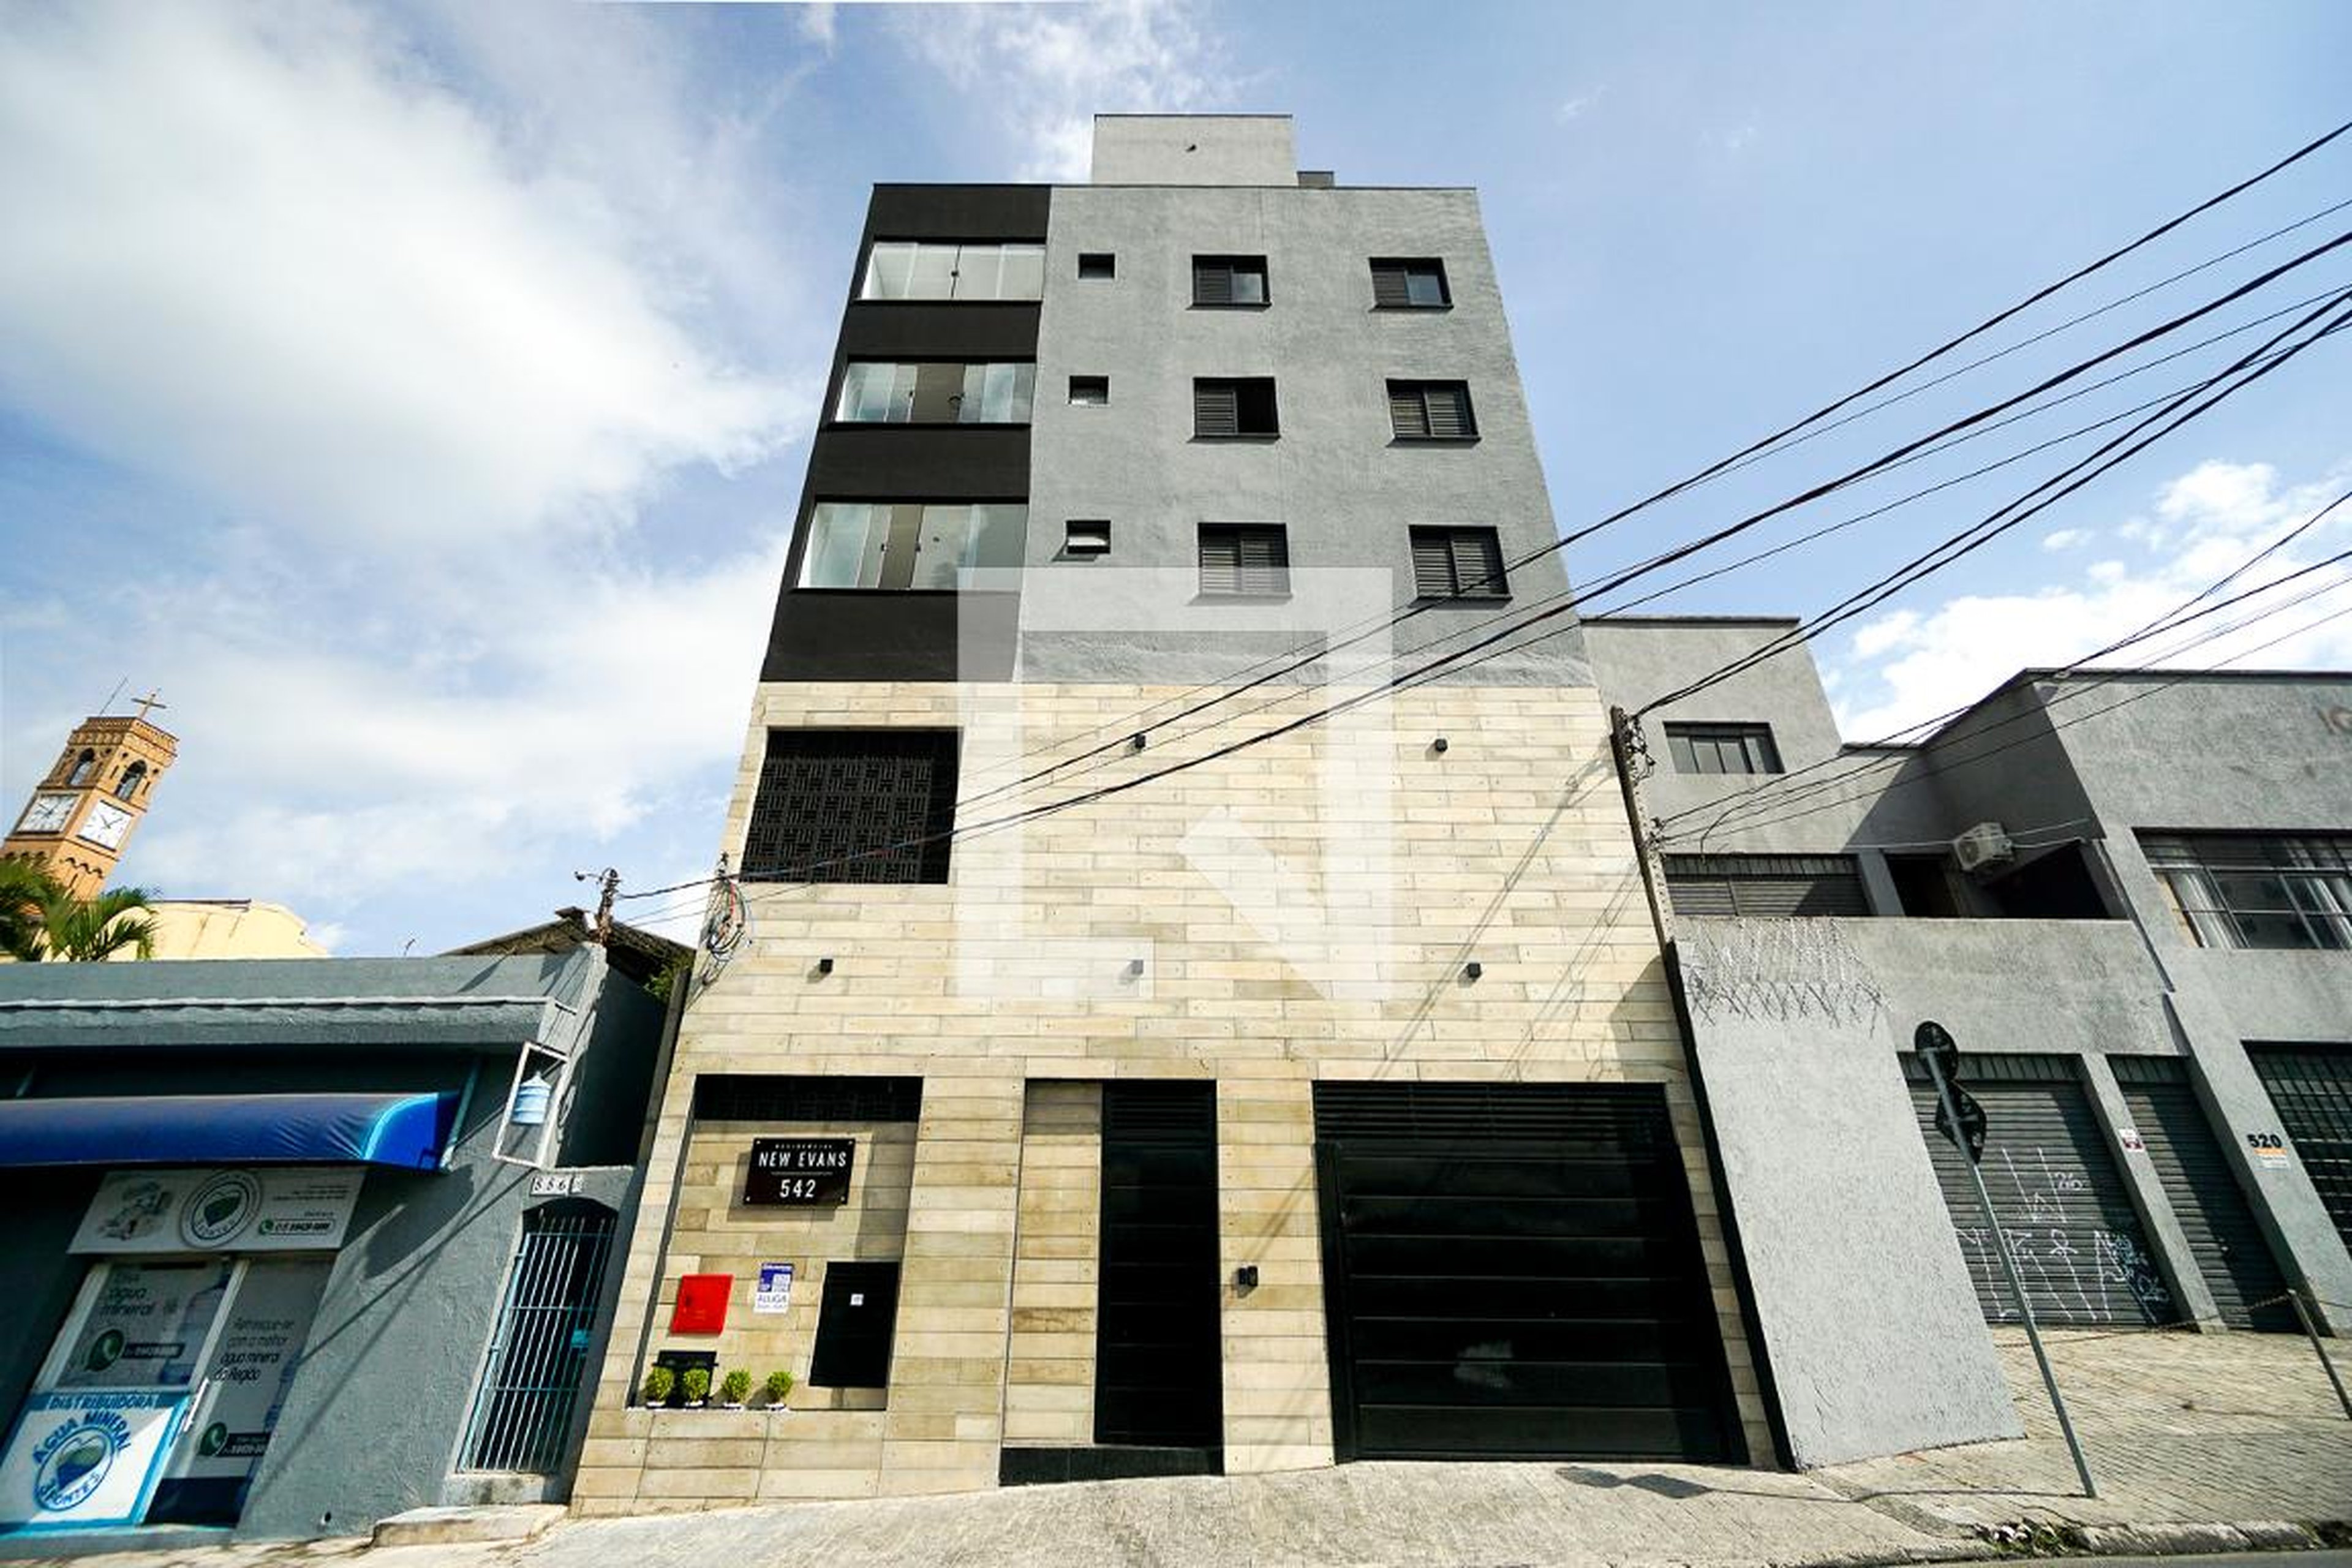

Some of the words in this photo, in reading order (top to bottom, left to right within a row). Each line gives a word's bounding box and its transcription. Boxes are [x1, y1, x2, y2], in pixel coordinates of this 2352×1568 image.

[2247, 1133, 2282, 1148] 520
[758, 1150, 791, 1167] NEW
[797, 1150, 847, 1167] EVANS
[779, 1178, 816, 1198] 542
[47, 1394, 159, 1409] DISTRIBUIDORA
[83, 1411, 131, 1451] MINERAL
